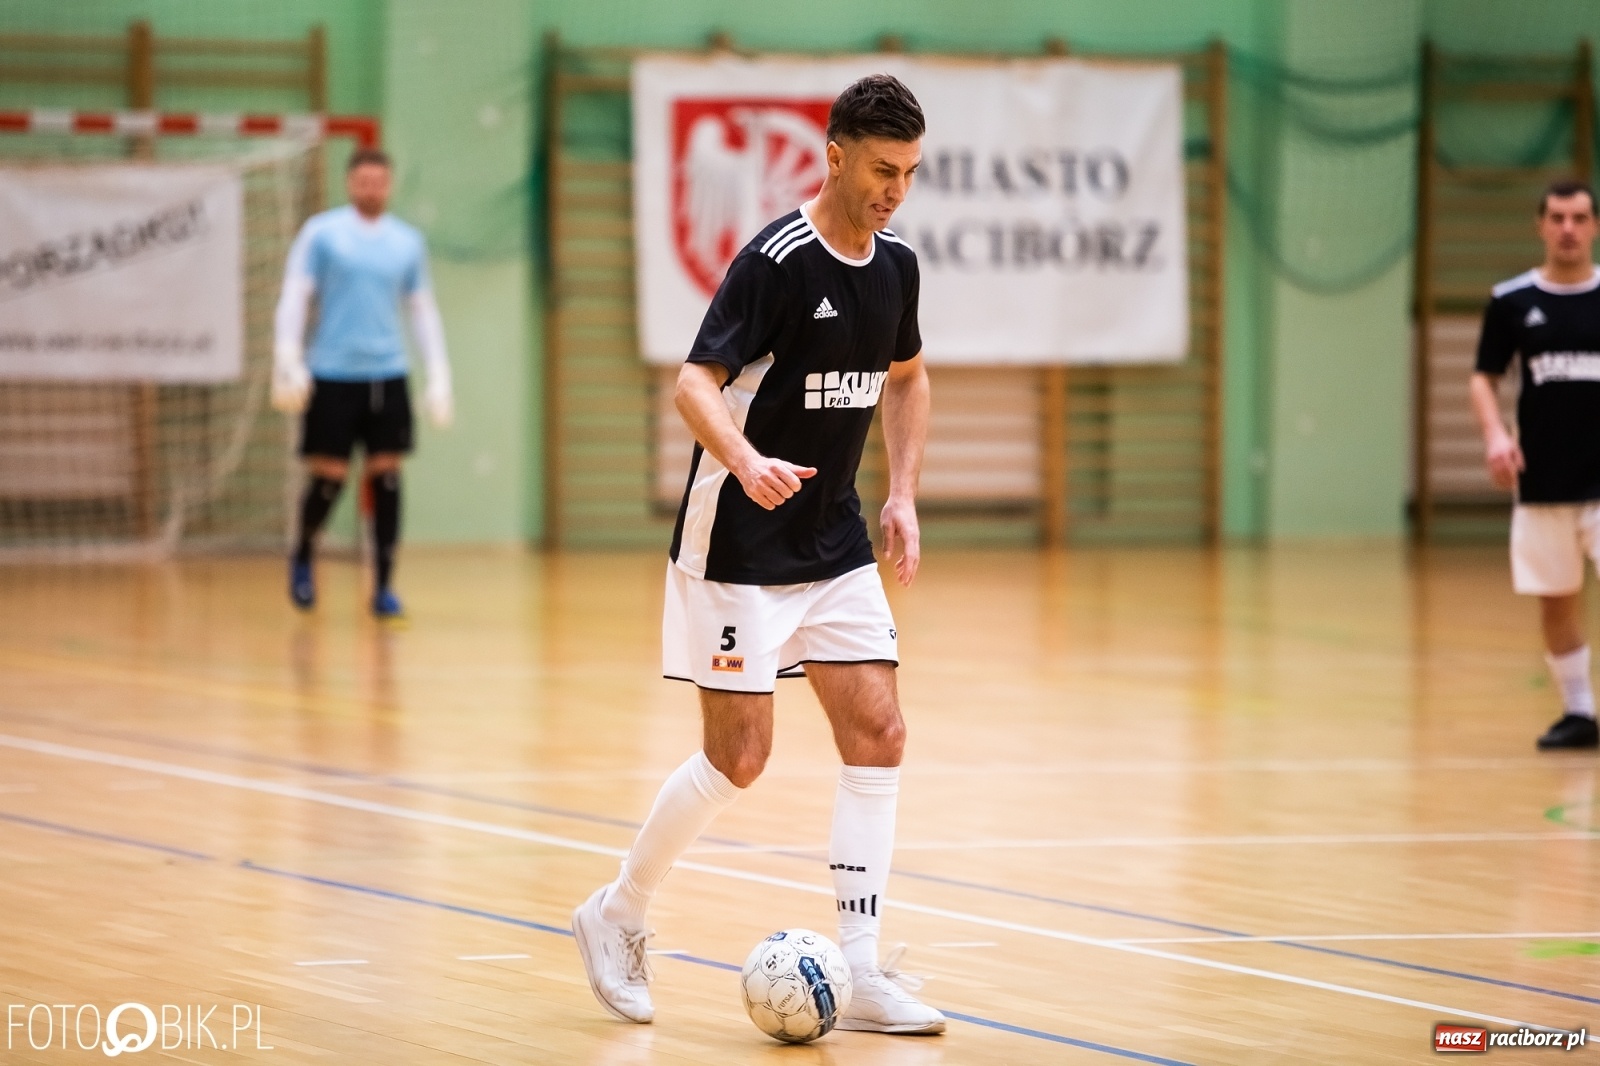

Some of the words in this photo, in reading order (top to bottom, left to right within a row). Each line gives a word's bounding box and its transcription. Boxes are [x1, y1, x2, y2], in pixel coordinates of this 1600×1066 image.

[899, 208, 1164, 270] ACIBÓRZ
[813, 309, 839, 320] adidas
[720, 626, 737, 651] 5
